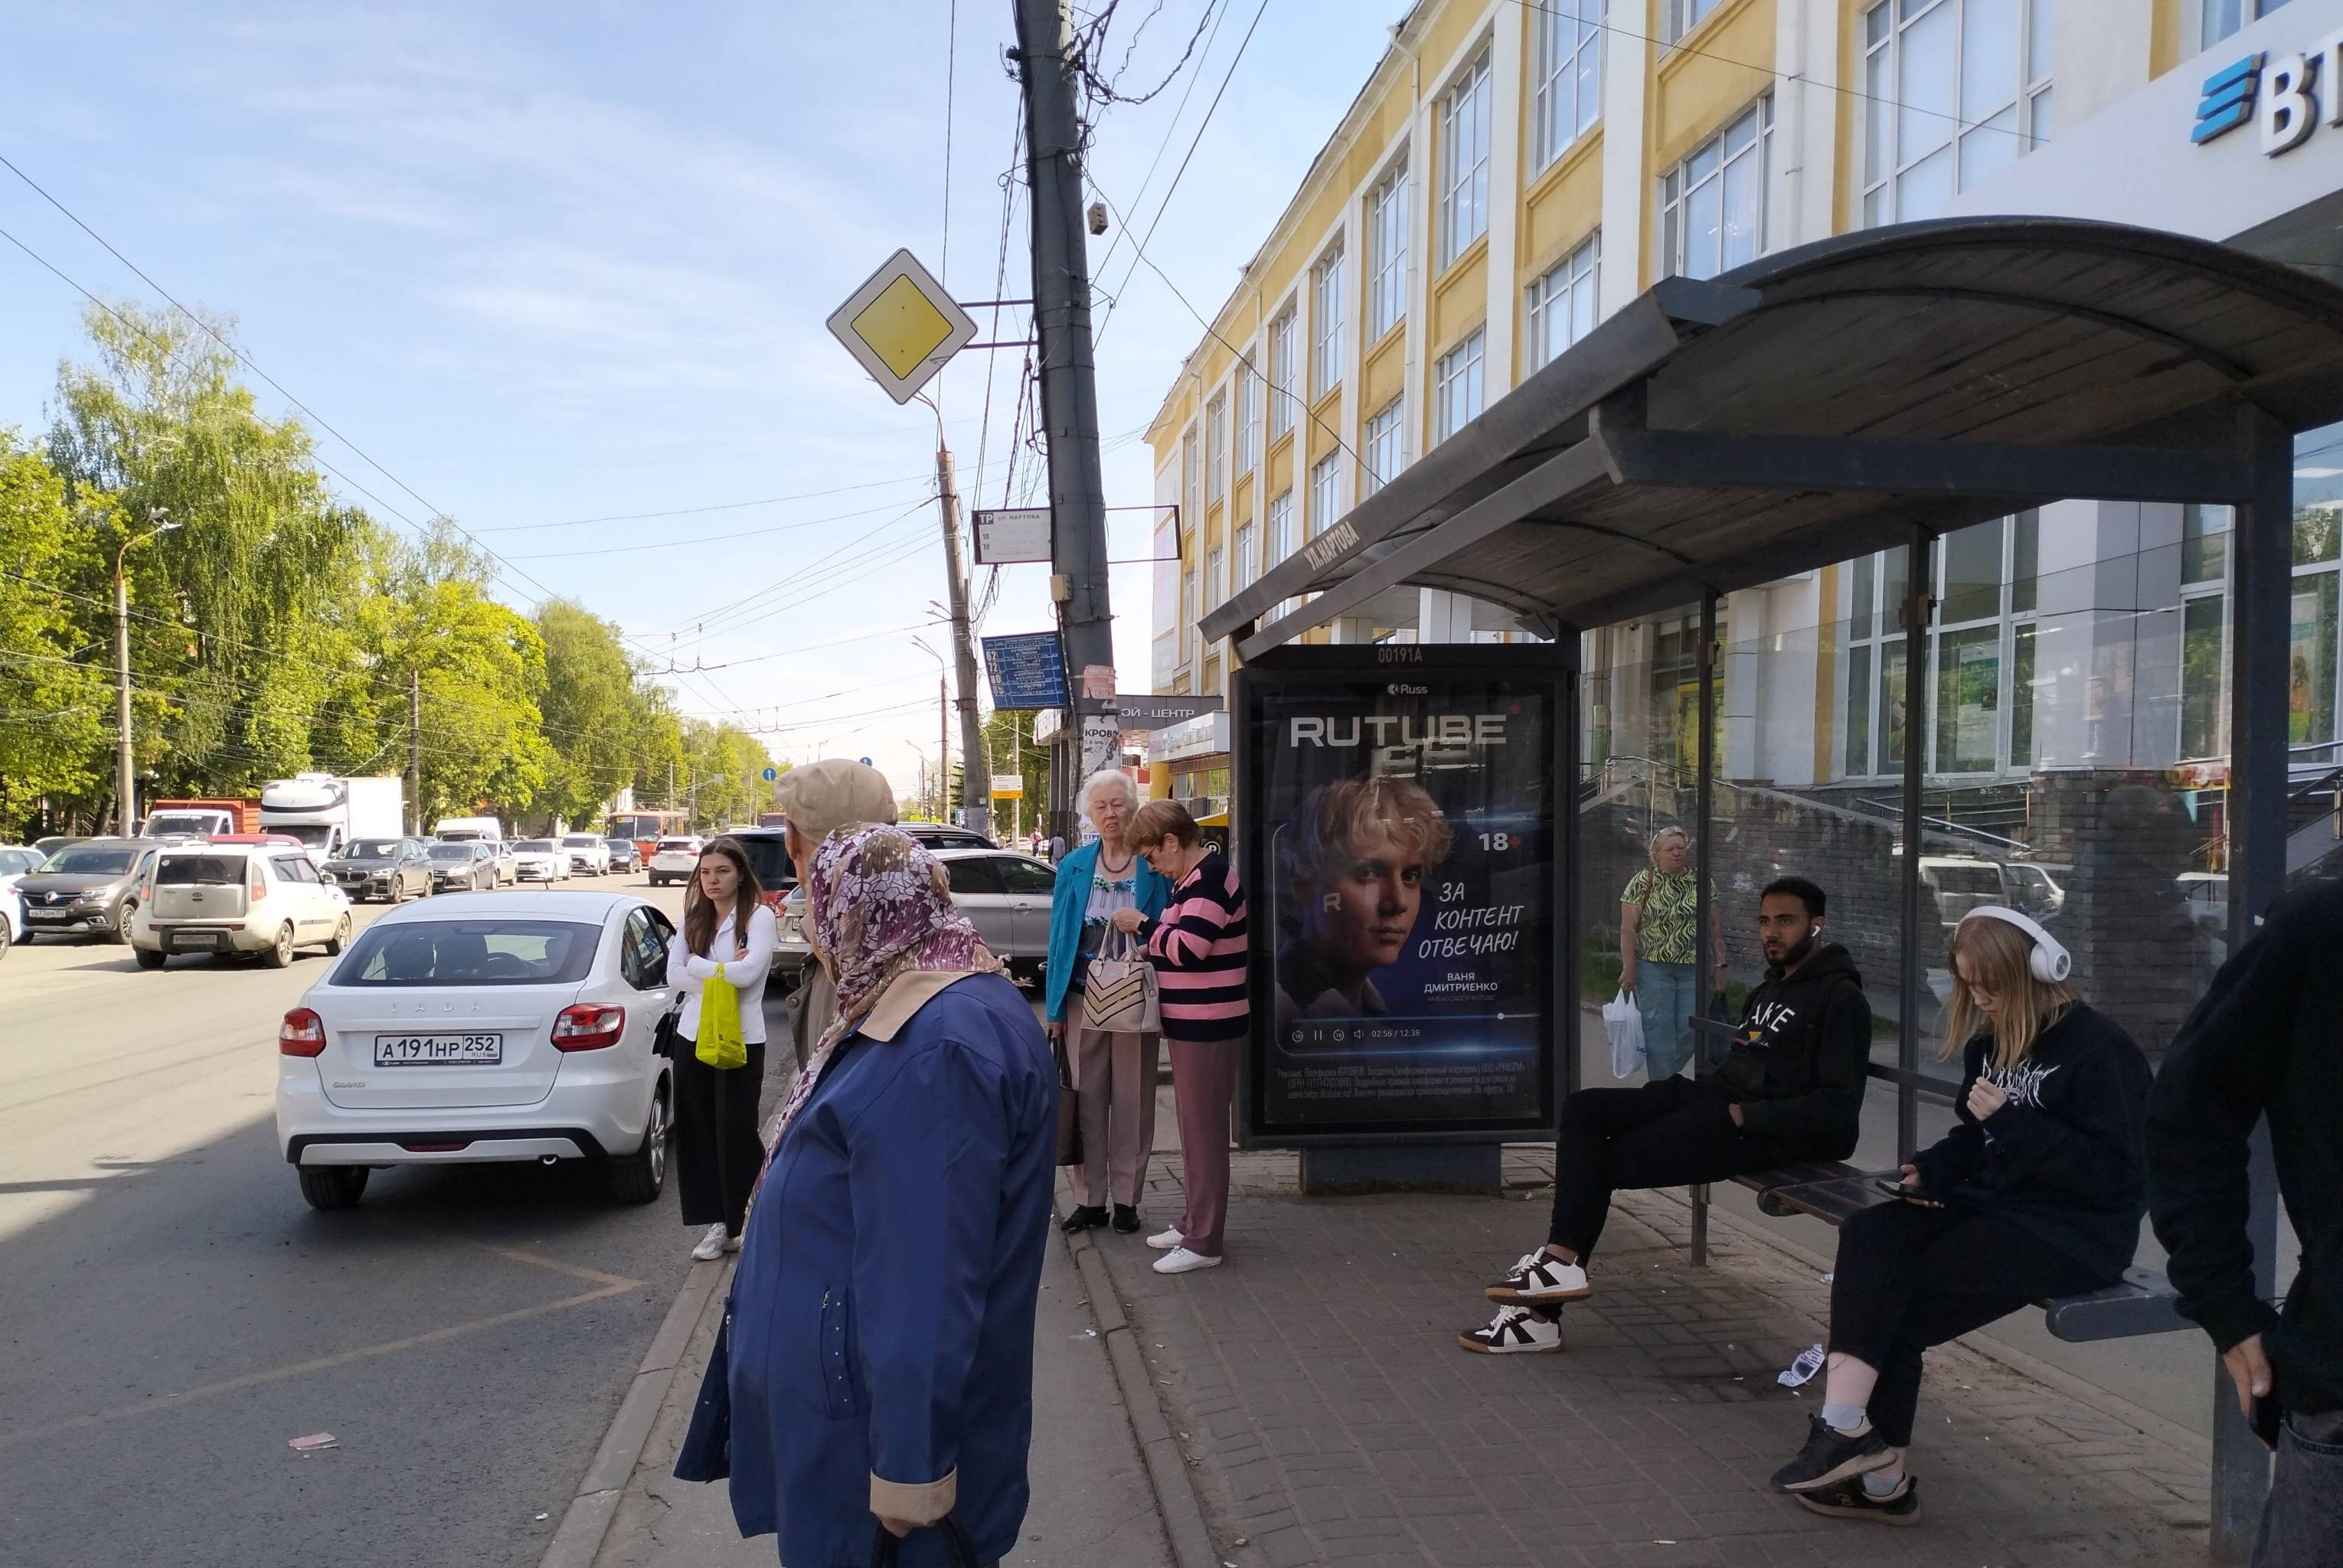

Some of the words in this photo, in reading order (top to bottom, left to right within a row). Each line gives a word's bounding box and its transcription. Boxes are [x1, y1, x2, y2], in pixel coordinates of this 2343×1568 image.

[979, 514, 993, 524] ТР
[1400, 684, 1428, 694] Russ
[1152, 709, 1194, 718] ЦЕНТР
[1290, 714, 1507, 747] RUTUBE
[1479, 832, 1521, 851] 18+
[1439, 882, 1465, 903] ЗА
[1322, 892, 1341, 913] R
[1434, 905, 1524, 931] КОНТЕНТ
[1418, 931, 1518, 959] ОТВЕЧАЮ!
[1447, 972, 1475, 982] ВАНЯ
[1424, 982, 1498, 994] ДМИТРИЕНКО
[391, 1003, 481, 1012] LADA
[383, 1038, 460, 1058] А191НР
[464, 1036, 495, 1051] 252
